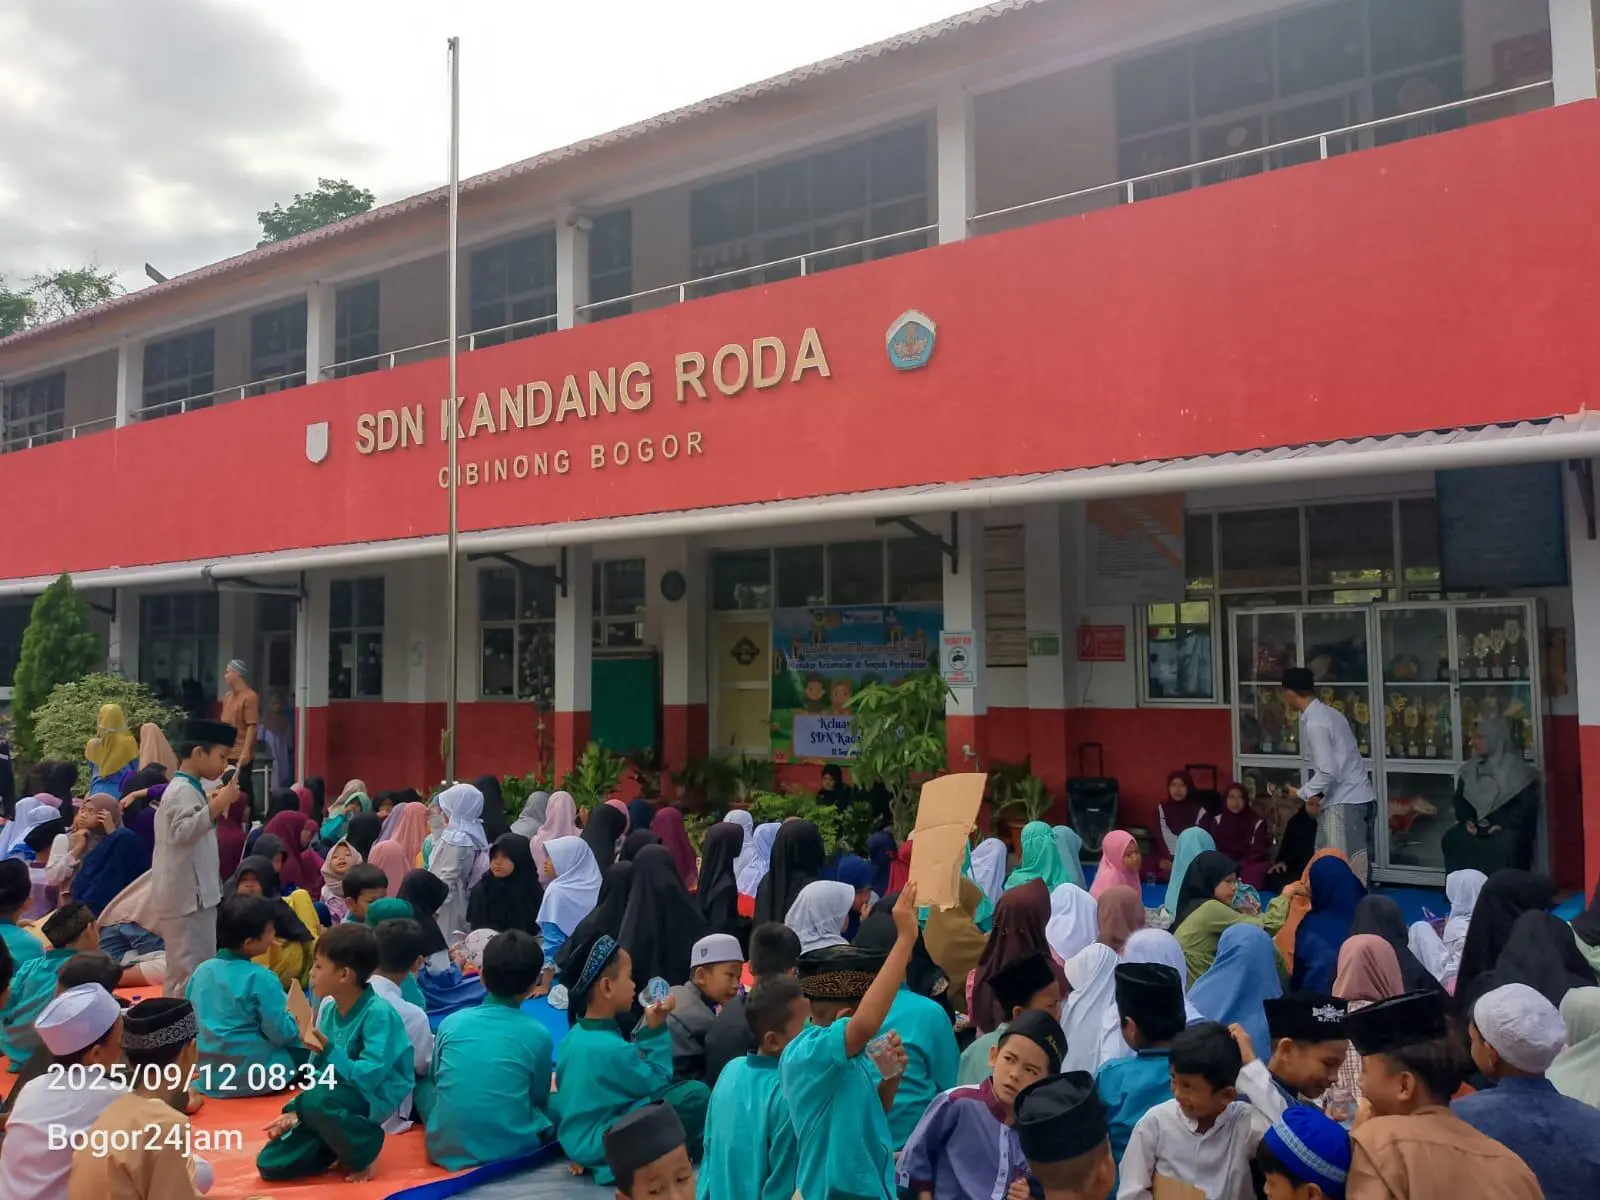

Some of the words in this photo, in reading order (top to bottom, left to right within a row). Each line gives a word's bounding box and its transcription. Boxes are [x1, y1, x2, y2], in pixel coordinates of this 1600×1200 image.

[355, 404, 424, 454] SDN
[441, 361, 651, 441] KANDANG
[675, 328, 831, 401] RODA
[591, 432, 703, 469] BOGOR
